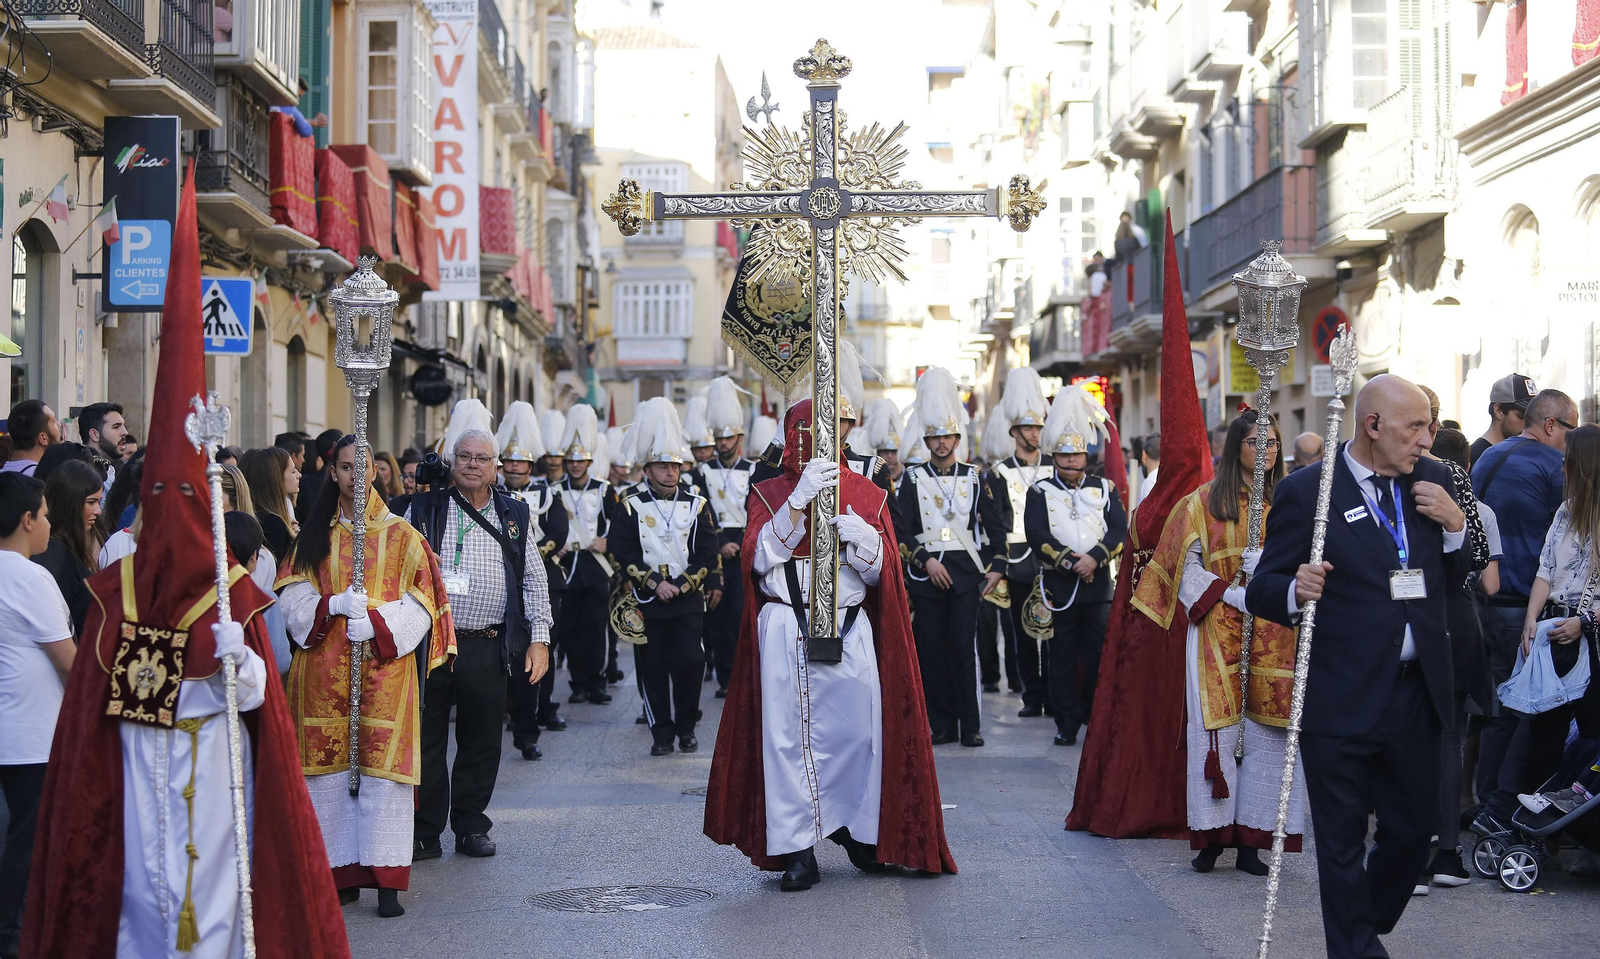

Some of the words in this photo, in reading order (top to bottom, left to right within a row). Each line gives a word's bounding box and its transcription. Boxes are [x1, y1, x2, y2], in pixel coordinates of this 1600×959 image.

[130, 151, 170, 168] Ciao
[121, 225, 163, 265] PARKING
[114, 268, 166, 278] CLIENTES
[740, 308, 761, 330] BANDA
